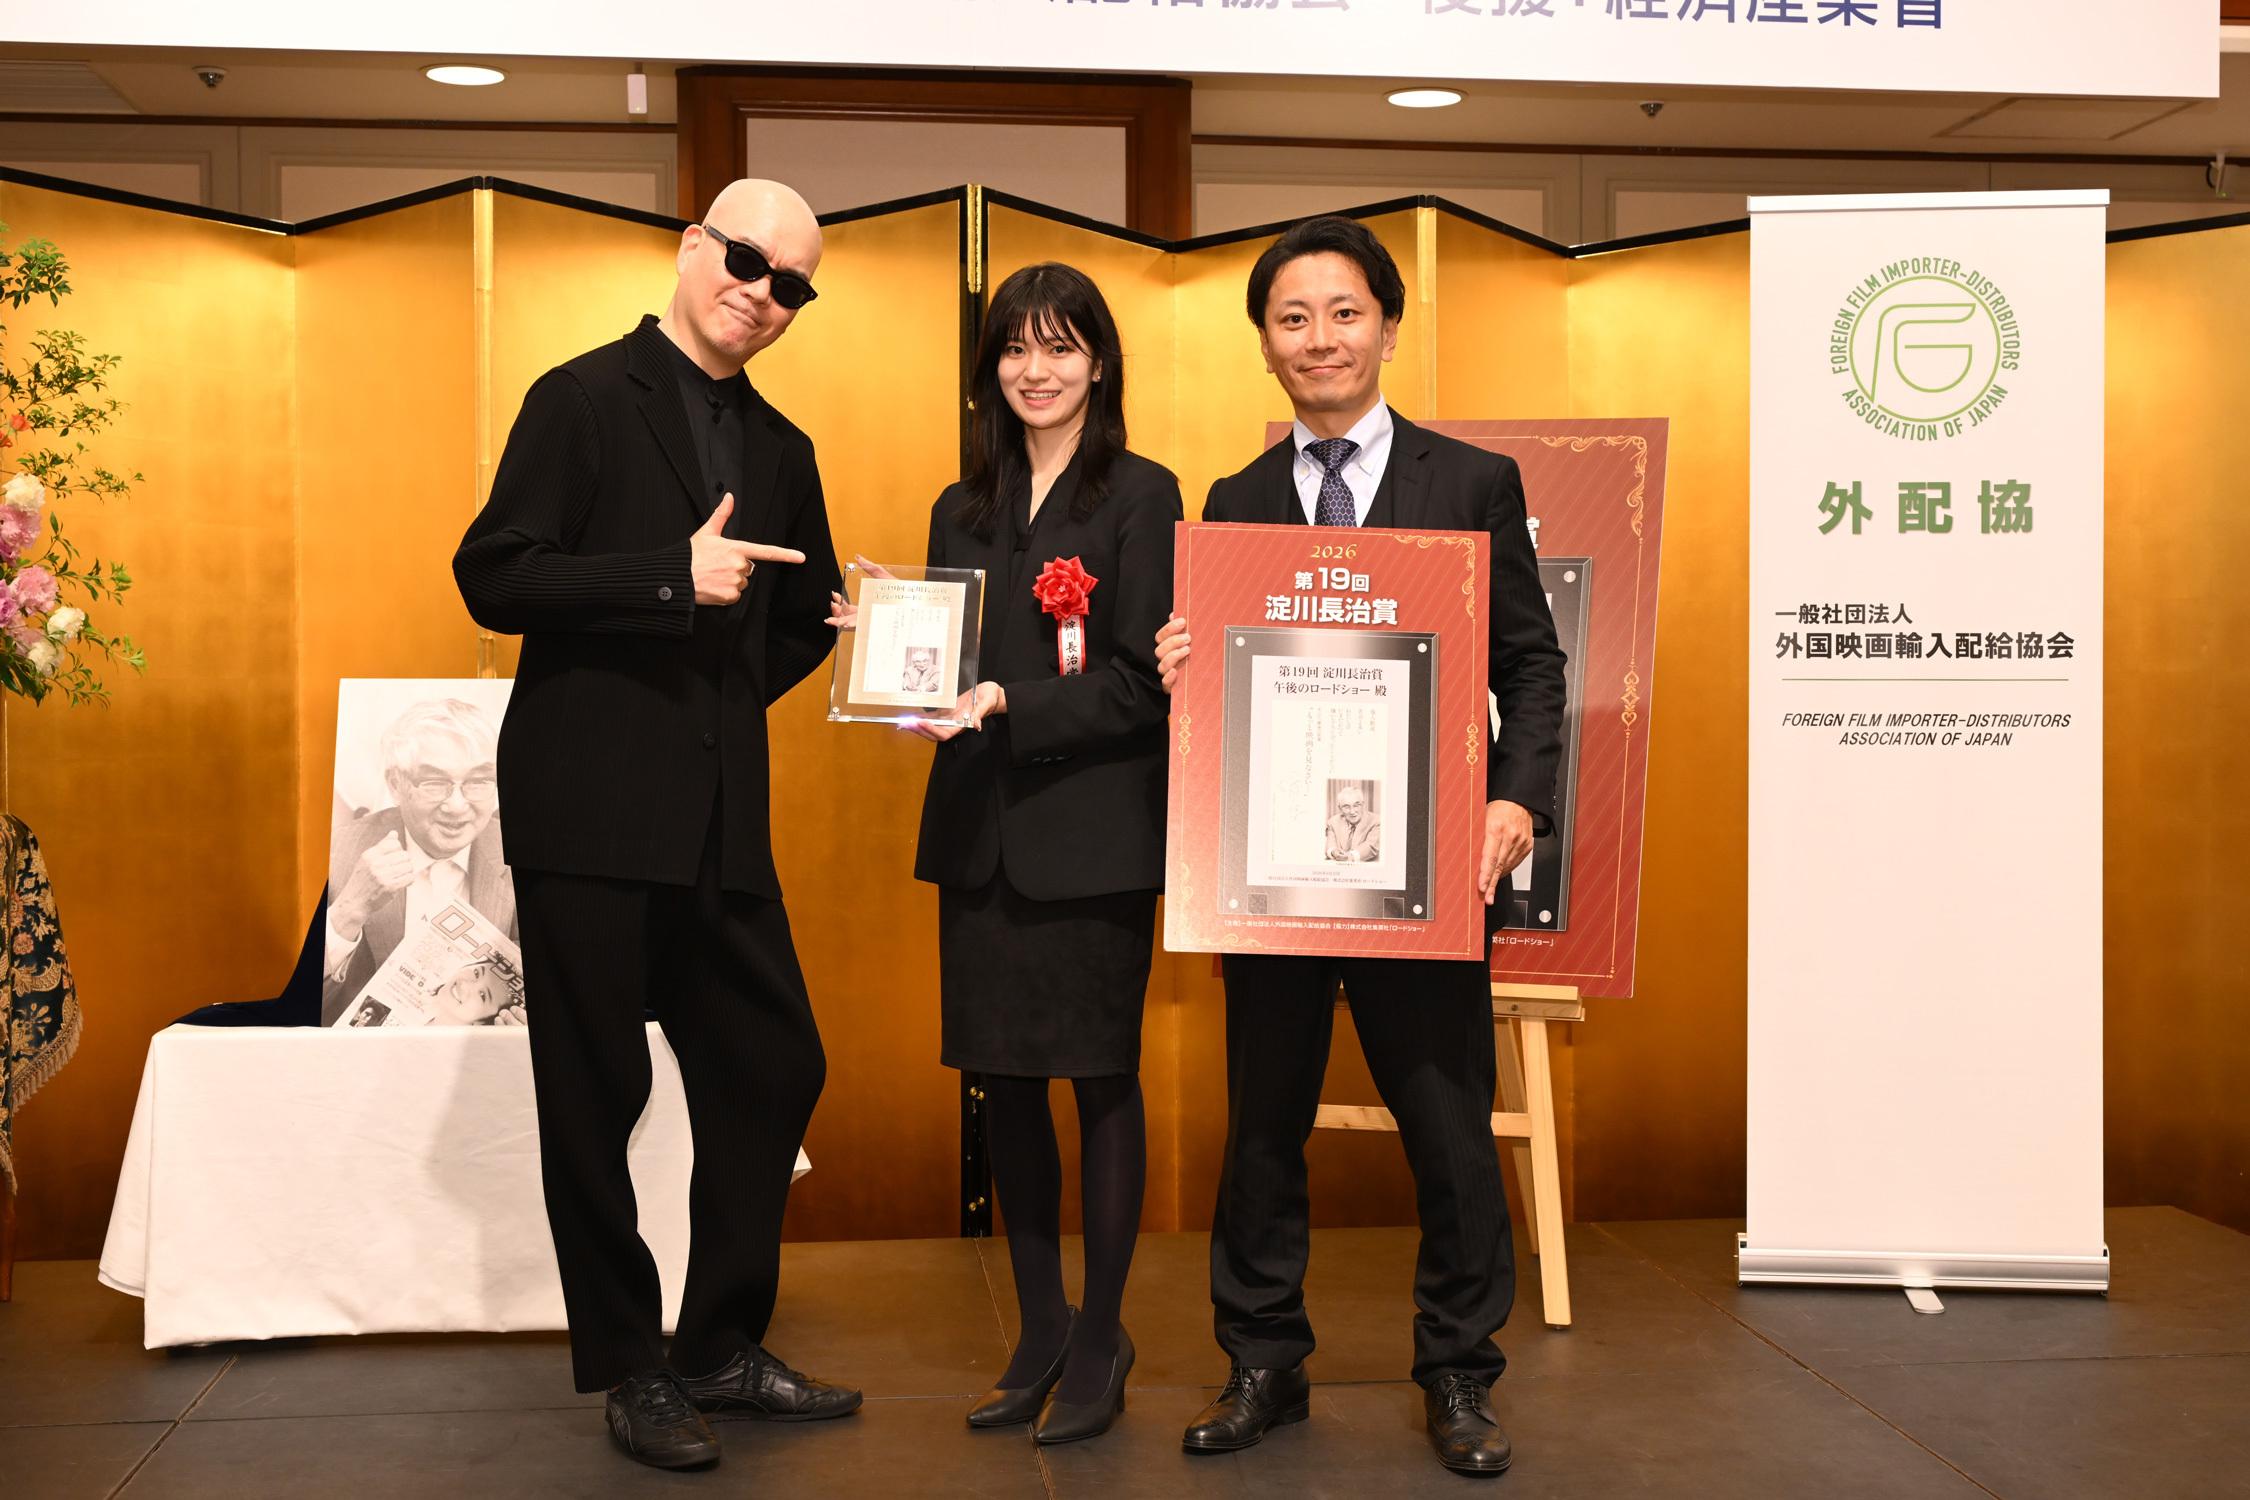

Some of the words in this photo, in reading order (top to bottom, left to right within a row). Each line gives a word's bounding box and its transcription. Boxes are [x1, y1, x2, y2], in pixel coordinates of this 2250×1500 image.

[1830, 307, 1856, 375] FOREIGN
[1847, 274, 1882, 309] FILM
[1880, 257, 2021, 371] IMPORTER-DISTRIBUTORS
[1841, 388, 1938, 442] ASSOCIATION
[1943, 417, 1964, 438] OF
[1969, 383, 2009, 428] JAPAN
[1817, 478, 2034, 536] 外配協
[1310, 544, 1357, 559] 2026
[1295, 567, 1370, 593] 第19回
[1265, 594, 1398, 625] 淀川長治賞
[1775, 602, 1914, 625] 一般社団法人
[1775, 631, 2075, 660] 外国映画輸入配給協会
[1279, 665, 1318, 680] 第19回
[1274, 681, 1371, 697] 午後のロードショー
[1782, 713, 1845, 727] FOREIGN
[1847, 713, 1882, 727] FILM
[1885, 713, 2072, 728] IMPORTER-DISTRIBUTORS
[1839, 732, 1937, 746] ASSOCIATION
[1941, 732, 1962, 746] OF
[1964, 732, 2013, 747] JAPAN
